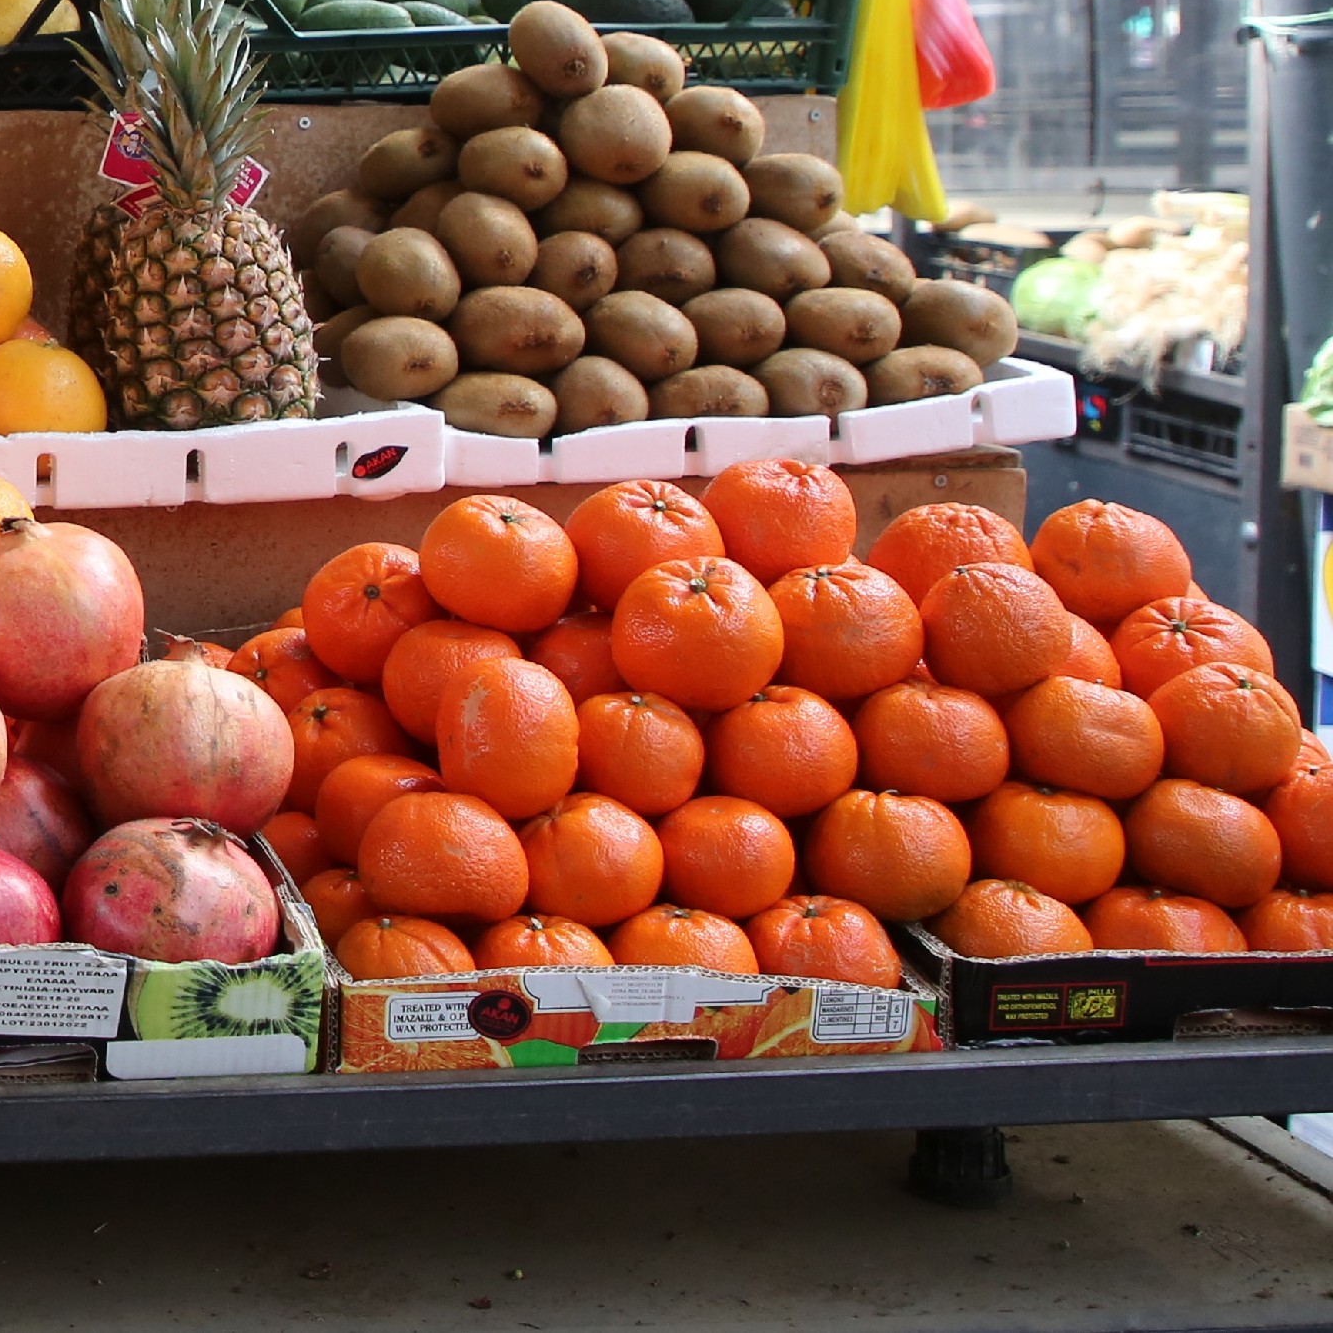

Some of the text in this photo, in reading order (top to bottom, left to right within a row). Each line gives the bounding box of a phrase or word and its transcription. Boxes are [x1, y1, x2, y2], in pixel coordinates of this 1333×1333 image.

[366, 447, 397, 469] AKAN
[401, 1002, 469, 1013] TREATED WITH
[894, 1005, 900, 1013] 6
[438, 1013, 446, 1021] &
[480, 1006, 519, 1025] AKAN
[396, 1024, 416, 1033] WAX
[419, 1022, 473, 1033] PROTECTED
[893, 1021, 899, 1029] 7
